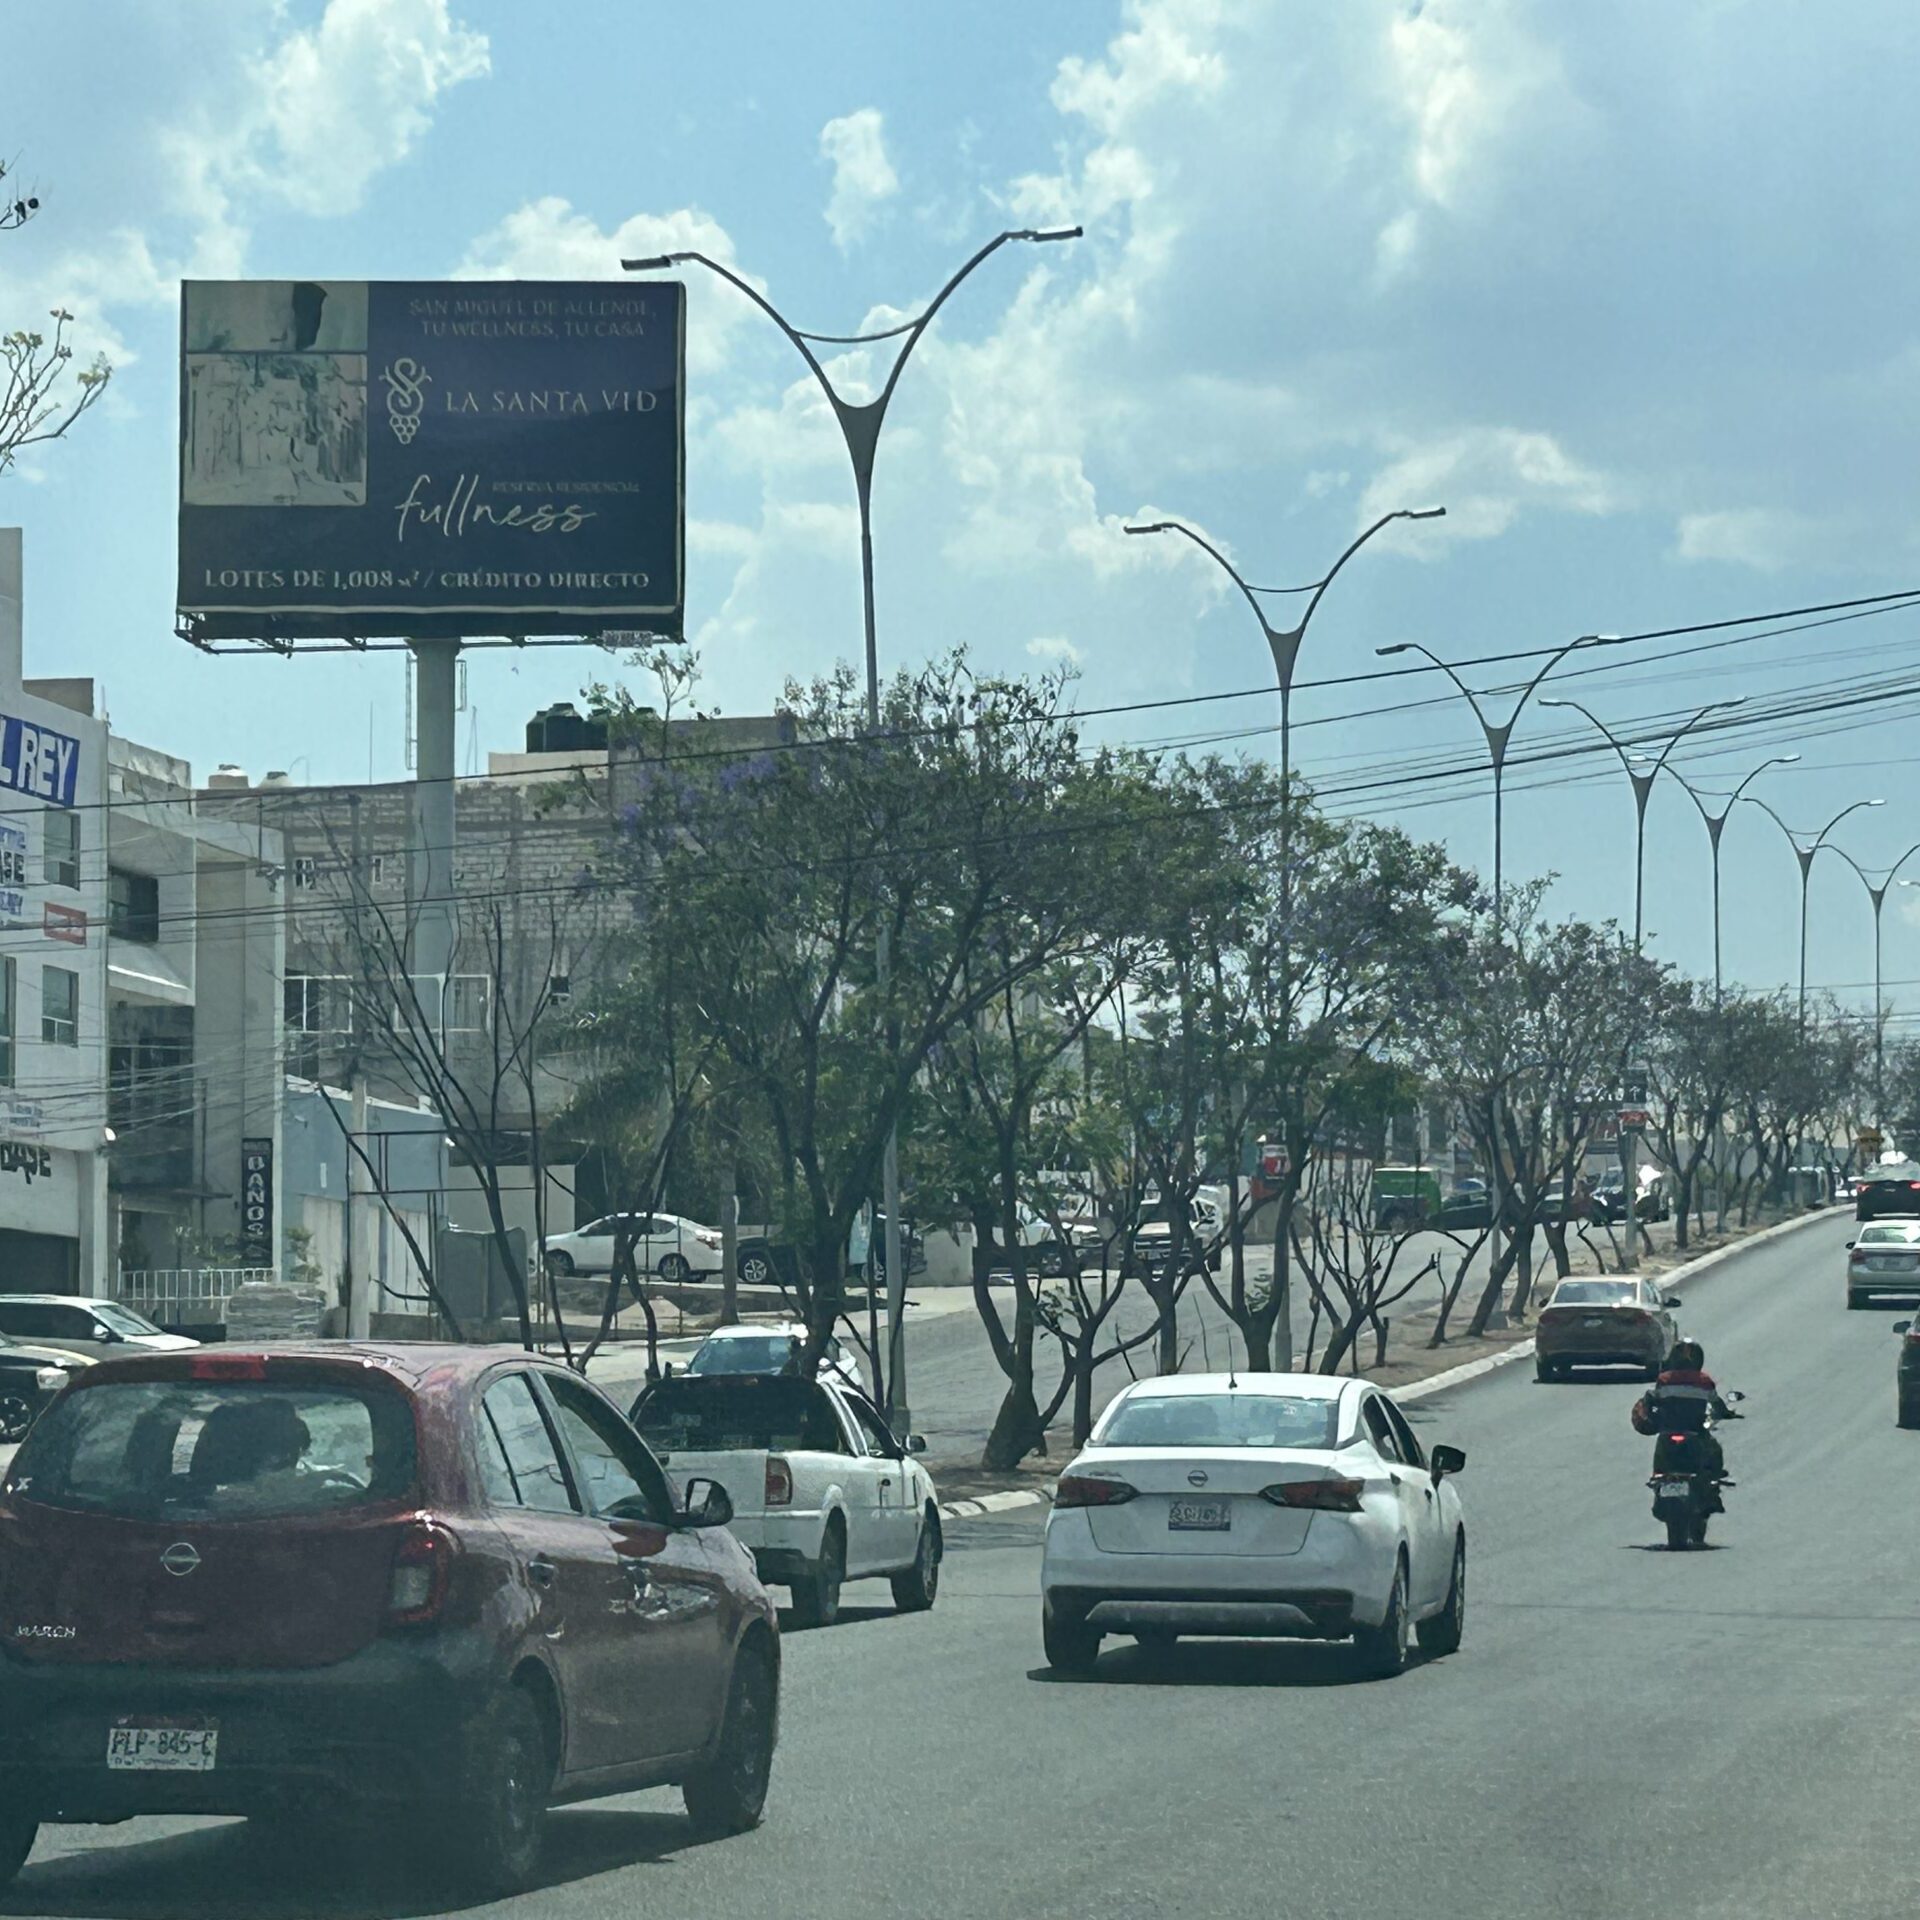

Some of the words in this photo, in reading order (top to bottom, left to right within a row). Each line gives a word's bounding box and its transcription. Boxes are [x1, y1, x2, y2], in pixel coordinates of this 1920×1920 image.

[421, 320, 446, 337] TU
[565, 320, 589, 337] TU
[594, 320, 645, 337] CASA
[446, 391, 480, 413] LA
[492, 391, 590, 416] SANTA
[601, 389, 657, 413] VID
[394, 474, 598, 542] fullness
[205, 568, 286, 590] LOTES
[293, 569, 326, 589] DE
[440, 566, 543, 590] CRÉDITO
[548, 571, 650, 588] DIRECTO
[17, 724, 74, 801] REY
